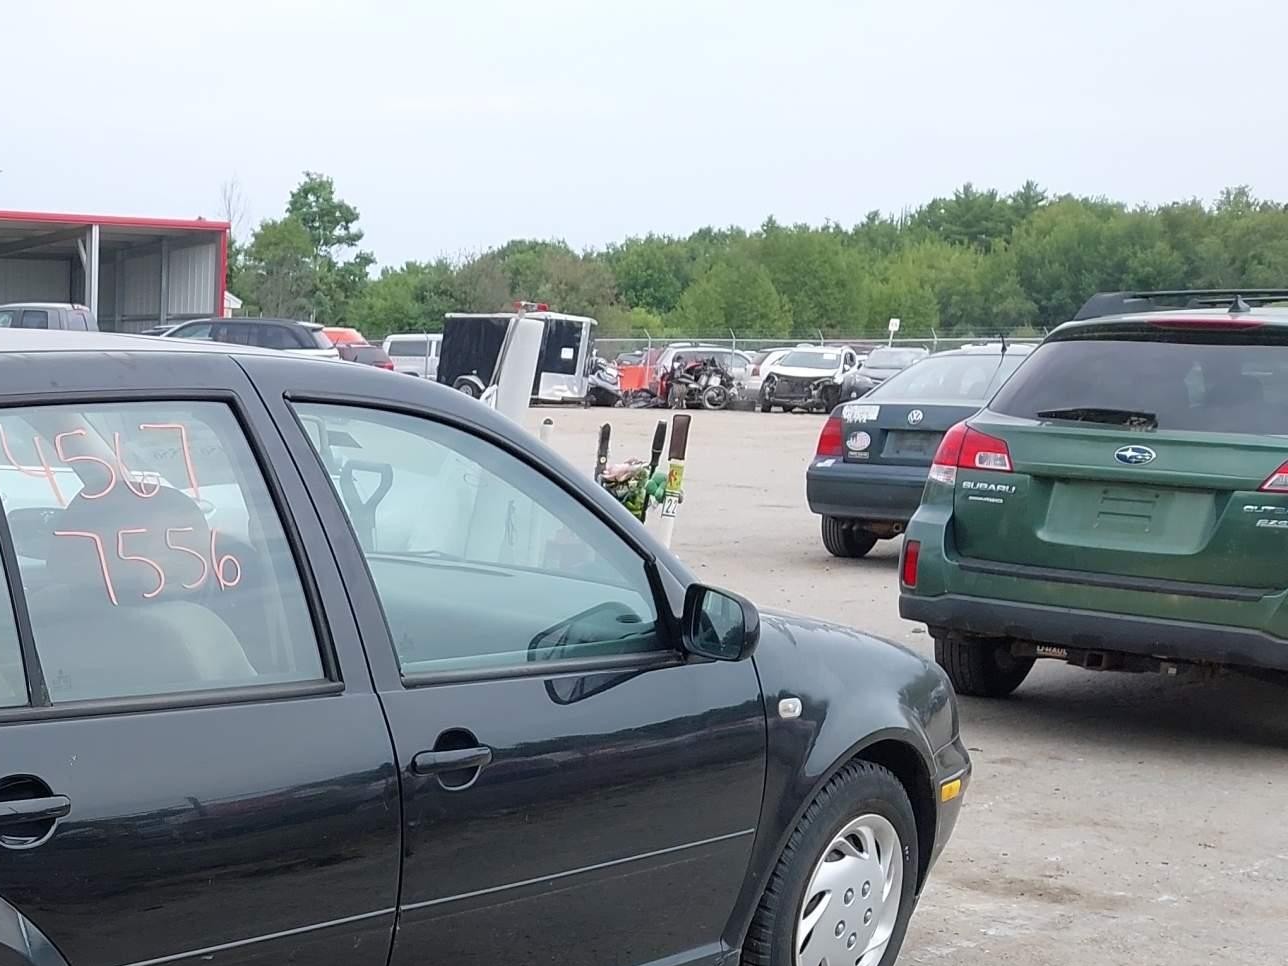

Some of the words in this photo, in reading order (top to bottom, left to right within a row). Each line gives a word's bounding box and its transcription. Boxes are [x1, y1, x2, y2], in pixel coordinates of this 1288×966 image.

[962, 481, 1016, 494] SUBARU
[1243, 505, 1288, 515] OUTB
[54, 527, 242, 606] 7556
